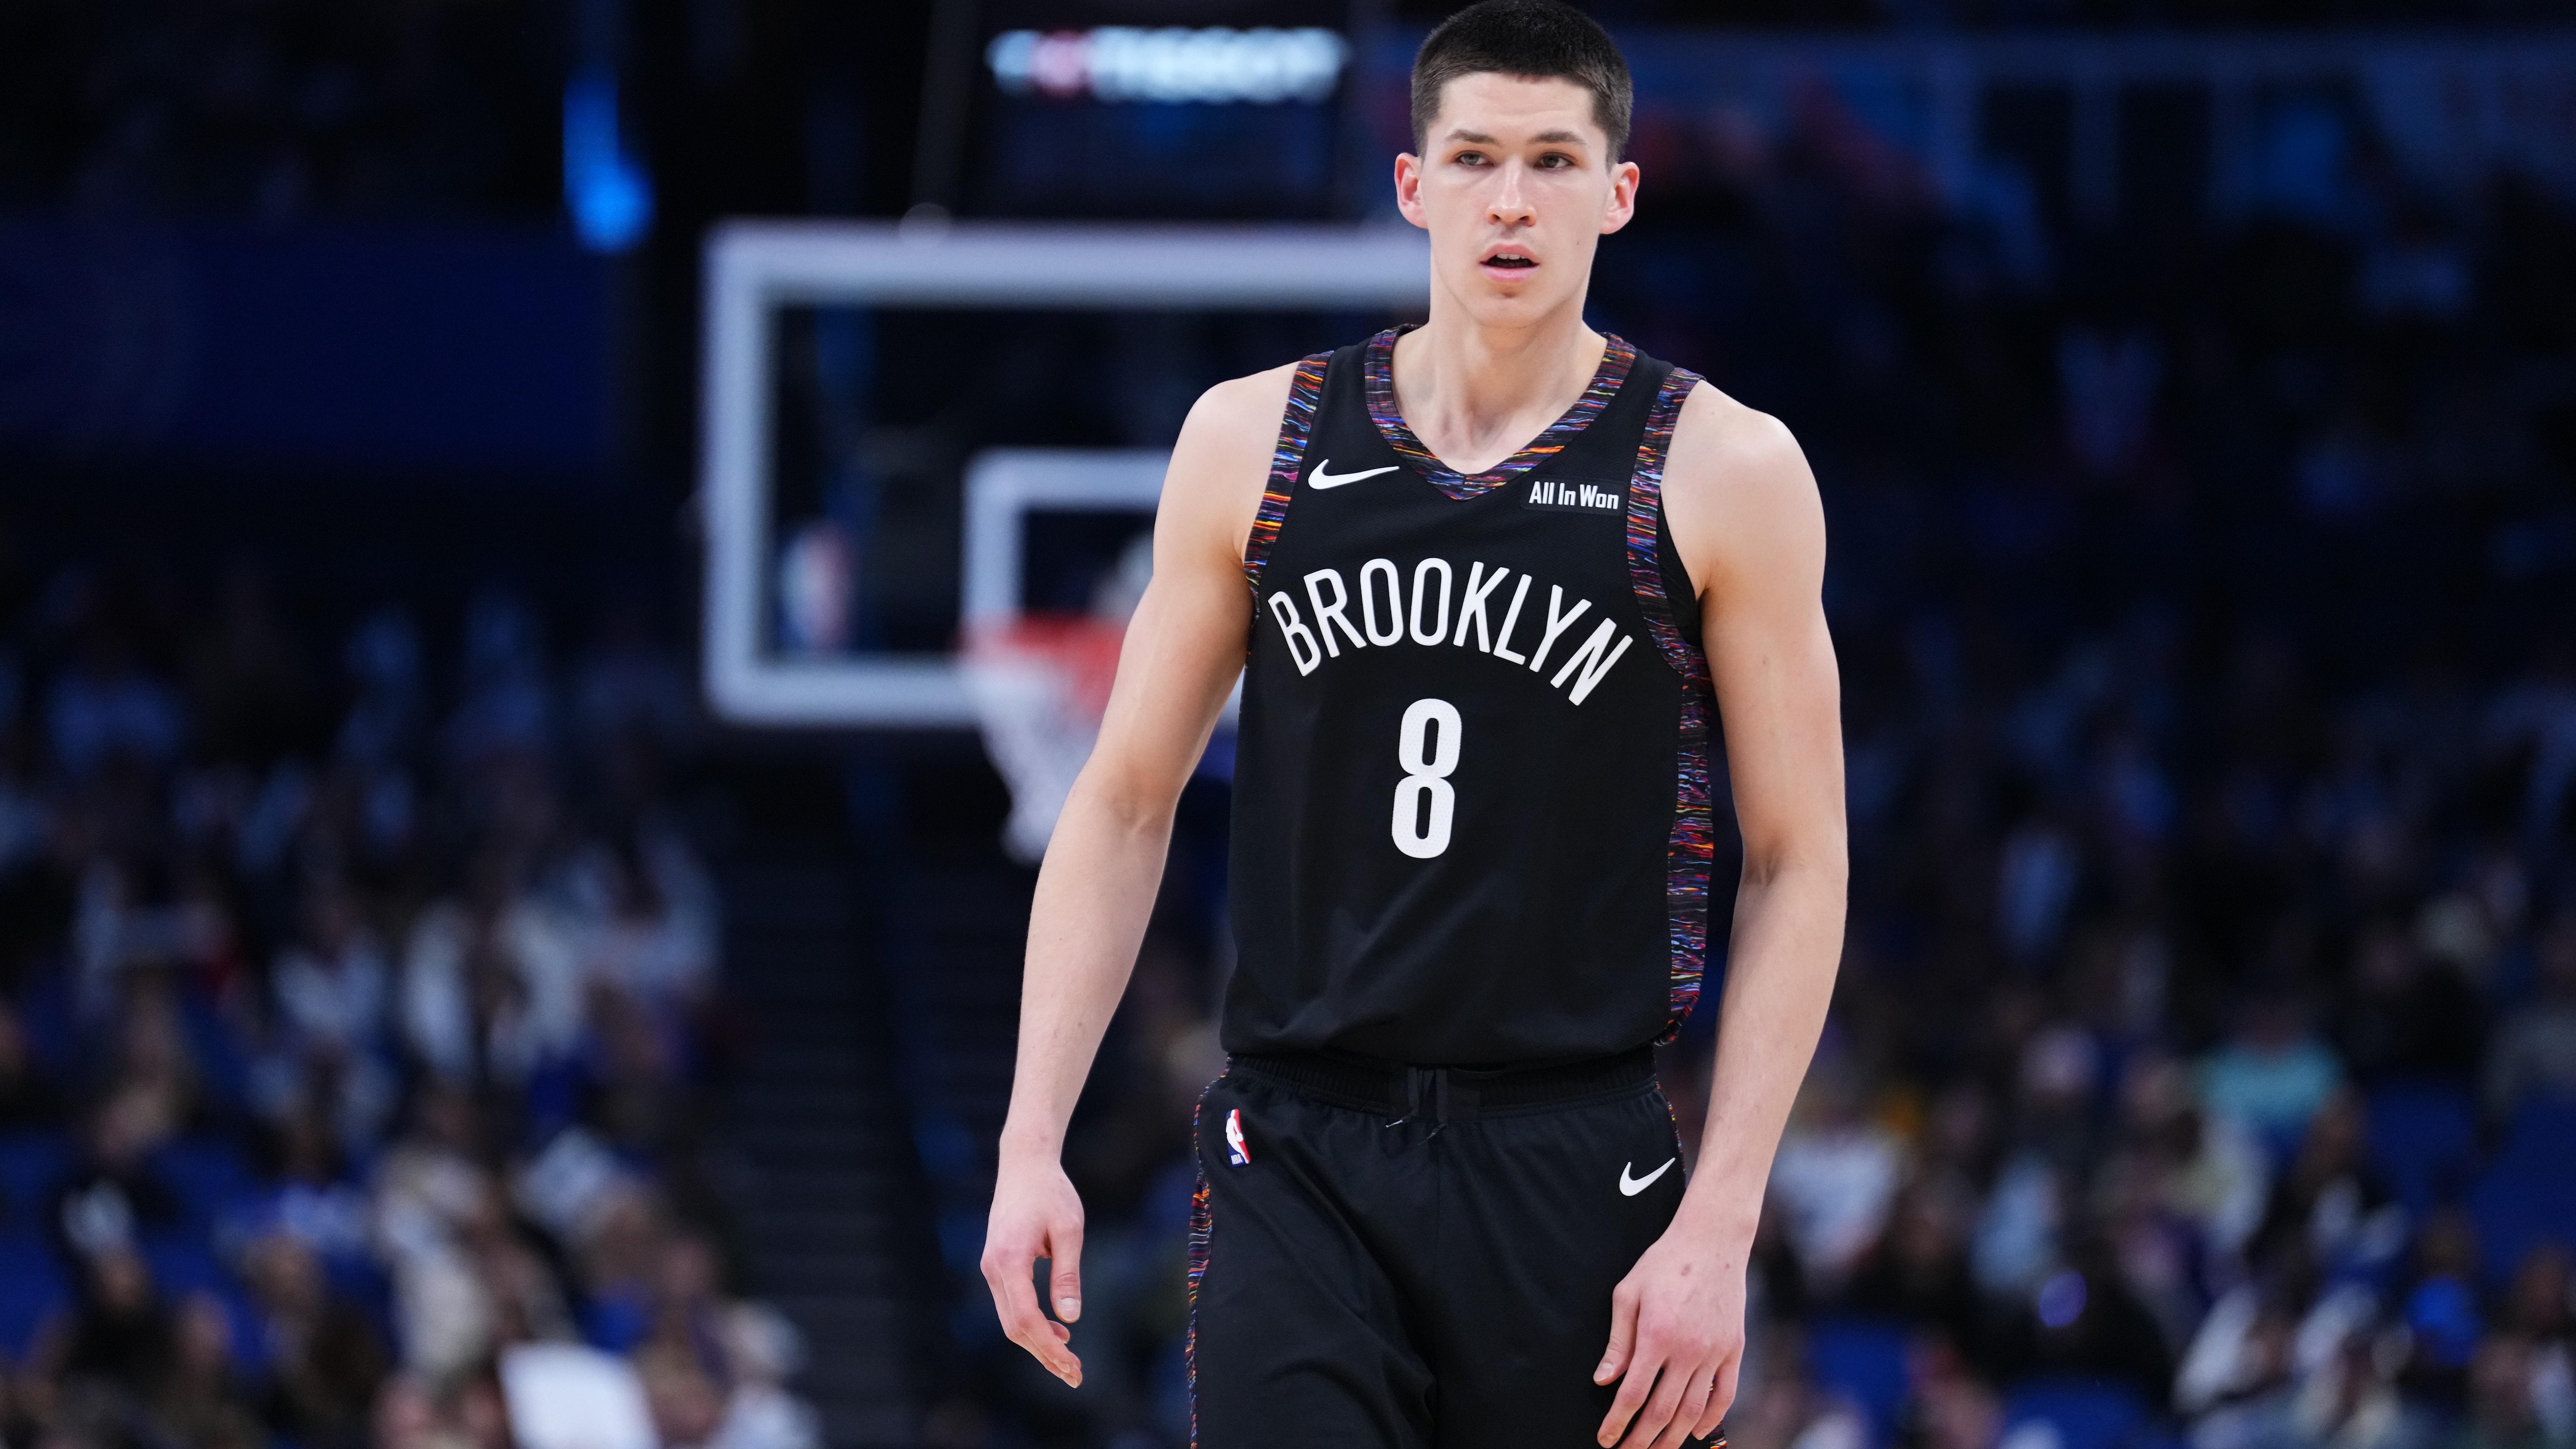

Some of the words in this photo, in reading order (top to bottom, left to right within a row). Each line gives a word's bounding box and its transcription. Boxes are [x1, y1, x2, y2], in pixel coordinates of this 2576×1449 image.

[1529, 481, 1555, 504] All
[1558, 483, 1576, 505] In
[1580, 484, 1619, 509] Won
[1267, 557, 1633, 706] BROOKLYN
[1392, 698, 1462, 859] 8
[1230, 1154, 1243, 1165] NBA
